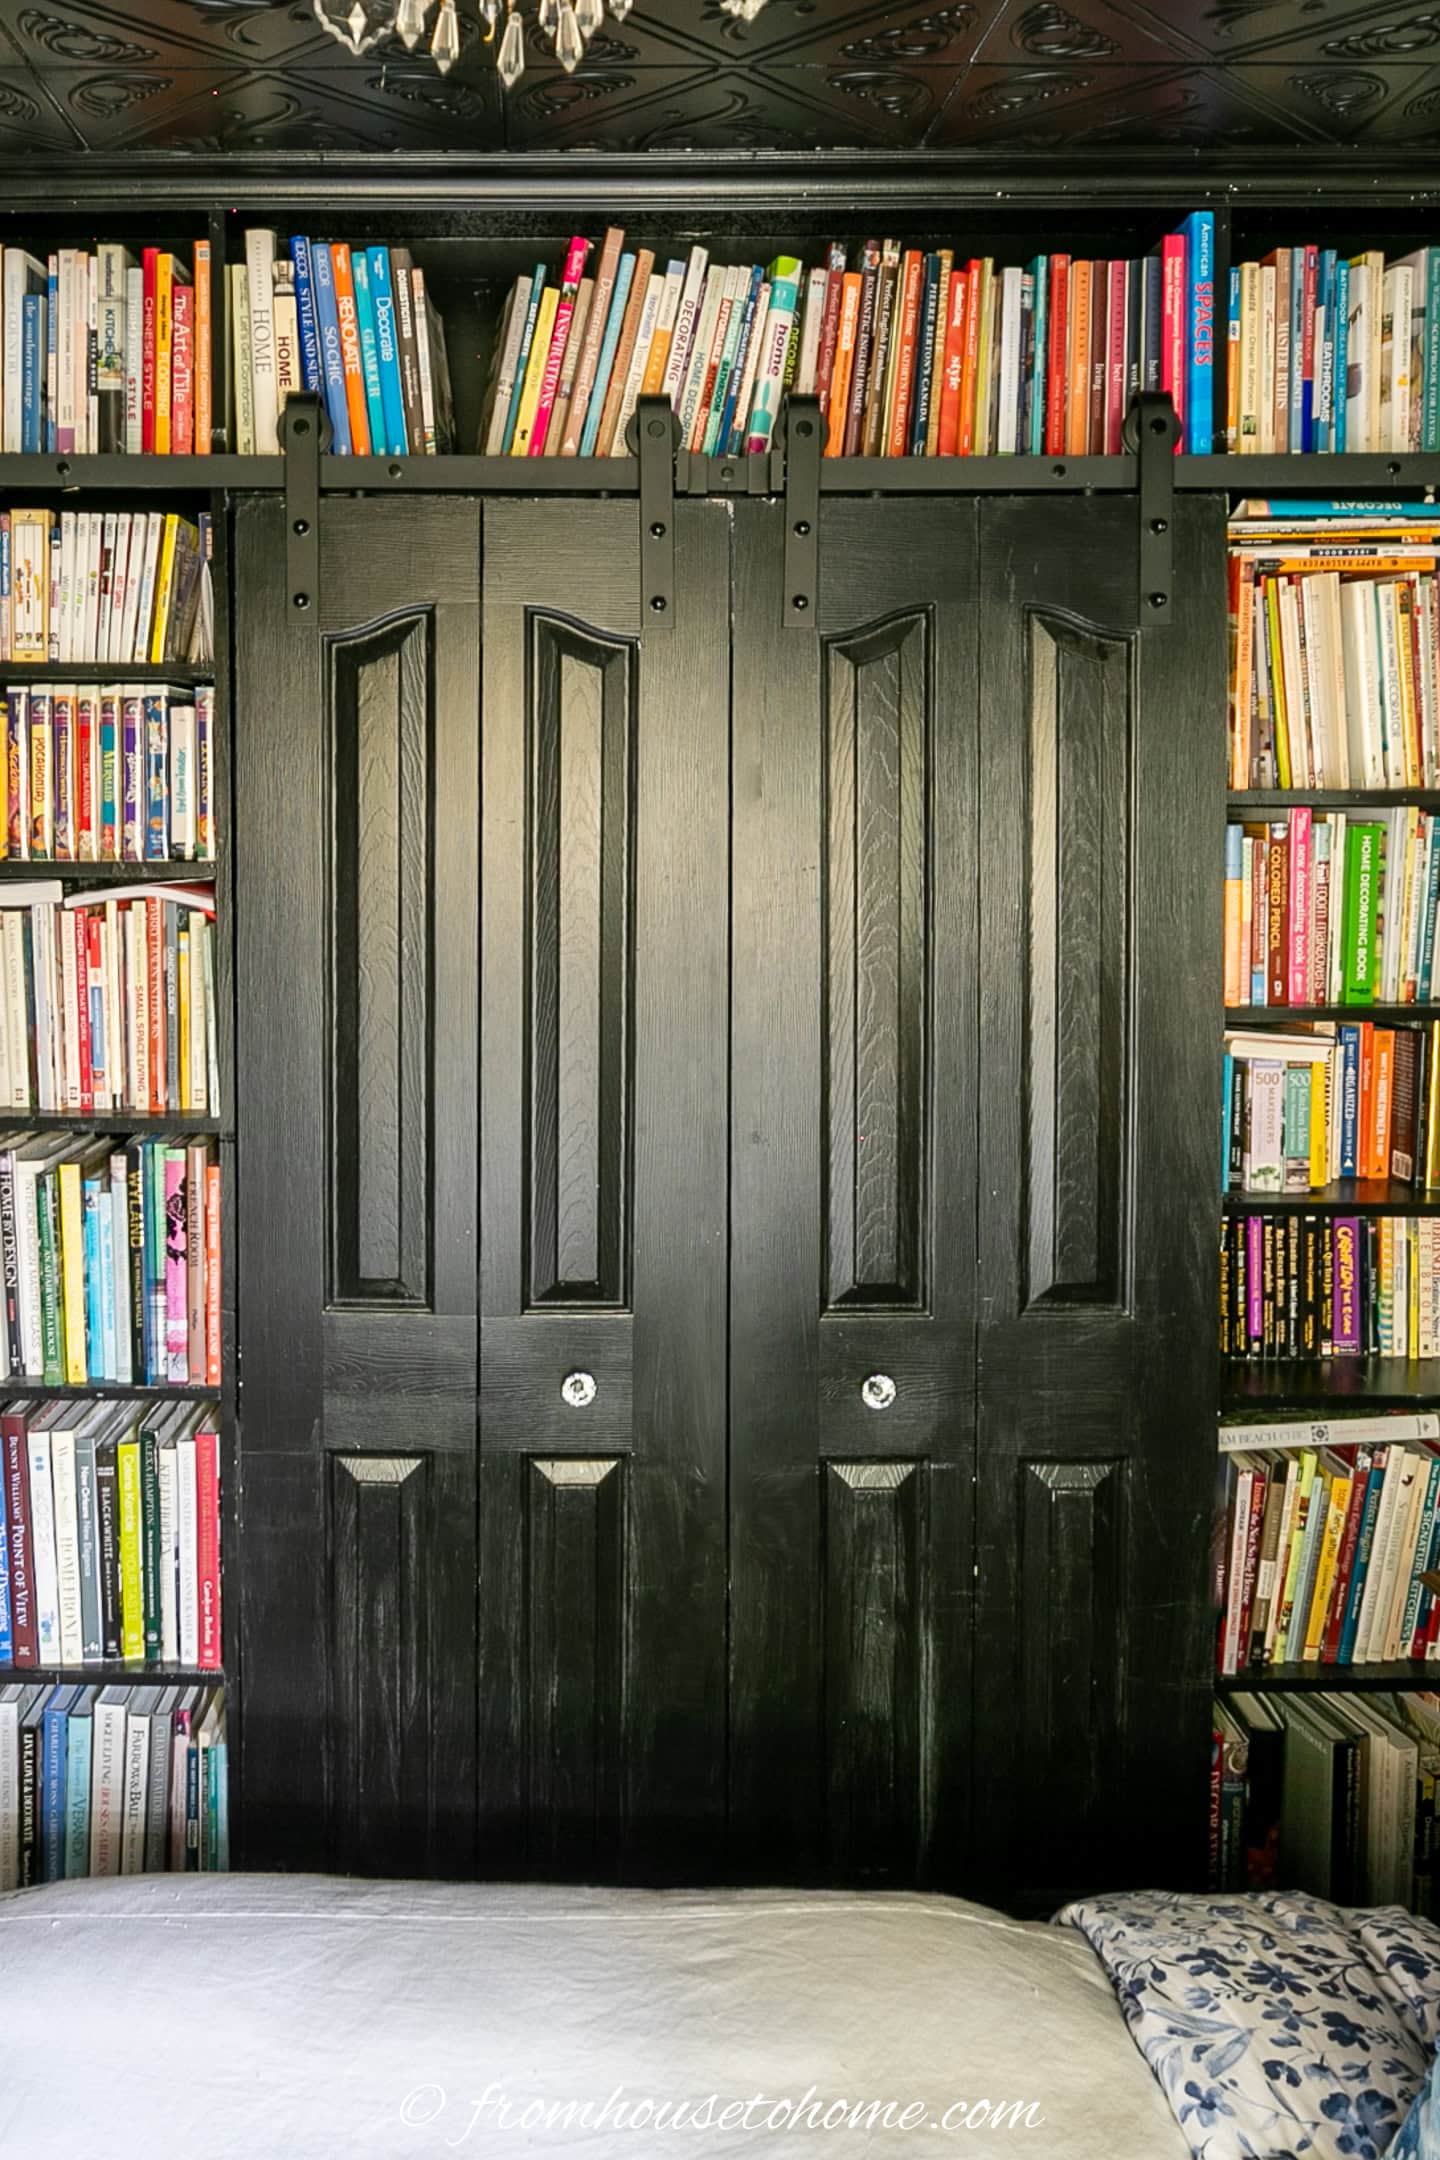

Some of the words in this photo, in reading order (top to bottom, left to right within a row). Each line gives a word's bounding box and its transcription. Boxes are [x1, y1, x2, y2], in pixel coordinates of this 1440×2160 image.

[1200, 224, 1211, 276] American
[881, 280, 894, 311] Perfect
[906, 264, 919, 300] Creating
[26, 302, 36, 318] the
[175, 296, 186, 321] The
[300, 288, 310, 327] STYLE
[588, 278, 612, 343] Decorating
[861, 276, 874, 330] ROMANTIC
[928, 283, 937, 322] PIERRE
[145, 297, 153, 359] CHINESE
[174, 322, 189, 351] Art
[253, 309, 271, 374] HOME
[325, 326, 337, 347] SO
[339, 296, 359, 375] RENOVATE
[376, 297, 393, 361] Decorate
[668, 300, 694, 381] DECORATING
[878, 312, 889, 342] English
[905, 309, 914, 336] Home
[1195, 282, 1213, 365] SPACES
[26, 322, 36, 367] southern
[174, 355, 185, 368] of
[278, 336, 291, 387] HOME
[304, 330, 316, 357] AND
[541, 309, 571, 409] INSPIRATIONS
[771, 324, 789, 376] home
[784, 328, 800, 384] DECORATE
[856, 333, 870, 375] ENGLISH
[922, 326, 934, 375] BERTON'S
[158, 352, 168, 416] FLOORING
[174, 369, 189, 403] Tile
[327, 350, 341, 384] CHIC
[690, 352, 705, 386] HOME
[900, 346, 911, 389] KATHRYN
[947, 356, 961, 390] style
[1092, 363, 1104, 390] living
[1320, 341, 1333, 423] BATHROOMS
[24, 370, 34, 409] cottage
[128, 377, 136, 421] STYLE
[144, 364, 152, 409] STYLE
[852, 378, 865, 415] HOMES
[919, 378, 930, 422] CANADA
[894, 403, 907, 446] IRELAND
[1427, 409, 1436, 445] LIVING
[1242, 587, 1251, 636] decorating
[1241, 639, 1250, 663] ideas
[1388, 671, 1401, 738] DECORATOR
[1361, 835, 1371, 871] HOME
[1271, 846, 1281, 905] COLORED
[1294, 871, 1306, 933] decorating
[1317, 886, 1328, 918] room
[1357, 874, 1371, 946] DECORATING
[76, 914, 84, 955] KITCHEN
[1270, 908, 1280, 951] PENCIL
[1295, 935, 1304, 964] book
[1314, 922, 1327, 989] makeovers
[1356, 948, 1367, 981] BOOK
[77, 958, 85, 985] IDEAS
[135, 985, 144, 1020] SMALL
[168, 985, 176, 1014] OLSON
[136, 1023, 144, 1056] SPACE
[137, 1059, 145, 1091] LIVING
[1255, 1072, 1280, 1085] 500
[0, 1175, 13, 1218] HOME
[128, 1170, 144, 1248] WYLAND
[190, 1181, 199, 1228] FRENCH
[3, 1236, 17, 1288] DESIGN
[190, 1232, 200, 1268] ROOM
[45, 1264, 53, 1294] AFFAIR
[46, 1295, 55, 1319] WITH
[9, 1436, 20, 1470] BUNNY
[144, 1440, 154, 1472] ALEXA
[81, 1466, 89, 1485] New
[145, 1473, 155, 1524] HAMPTON
[1252, 1482, 1263, 1512] Inside
[1352, 1483, 1365, 1510] Perfect
[1366, 1488, 1380, 1523] Perfect
[11, 1525, 24, 1567] POINT
[1345, 1513, 1361, 1542] English
[1359, 1526, 1375, 1563] English
[1413, 1511, 1432, 1576] SIGNATURE
[14, 1571, 25, 1588] OF
[127, 1550, 136, 1580] YOUR
[16, 1590, 28, 1627] VIEW
[128, 1583, 137, 1621] TASTE
[1402, 1581, 1420, 1639] KITCHENS
[102, 1747, 113, 1784] LIVING
[155, 1726, 168, 1776] CHARLES
[23, 1759, 34, 1783] LOVE
[50, 1779, 58, 1805] MOSS
[23, 1795, 33, 1843] DECORATE
[72, 1798, 86, 1857] VERANDA
